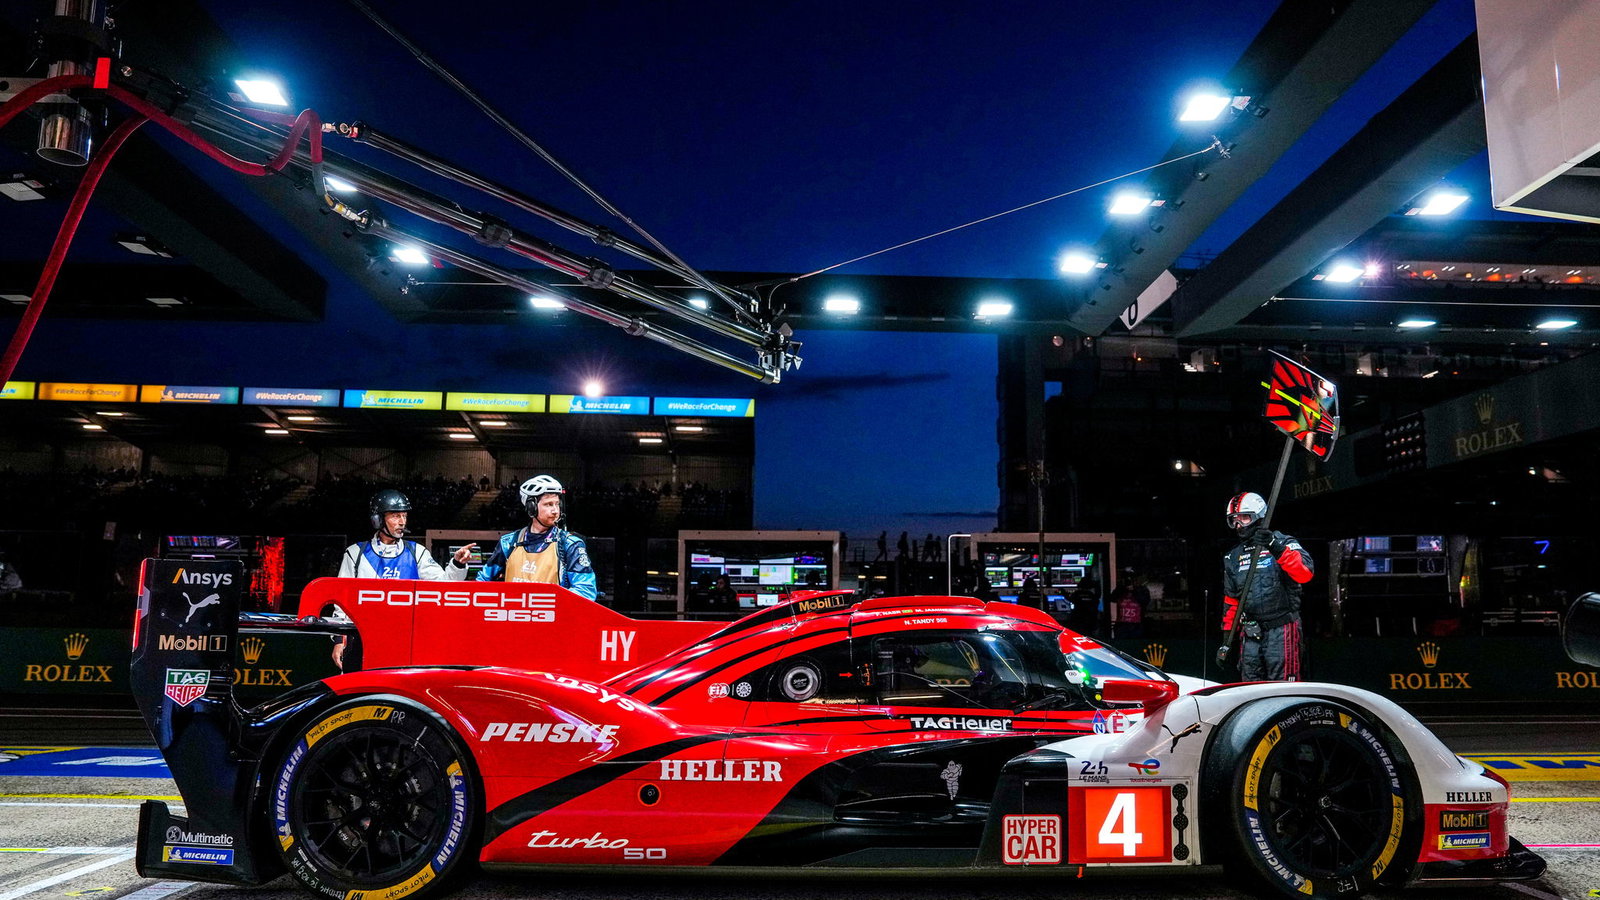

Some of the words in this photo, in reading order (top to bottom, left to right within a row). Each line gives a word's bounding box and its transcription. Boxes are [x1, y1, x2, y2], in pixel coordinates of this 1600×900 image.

[175, 392, 221, 400] MICHELIN
[255, 392, 322, 402] #WeRaceForChange
[462, 398, 529, 407] #WeRaceForChange
[585, 402, 631, 410] MICHELIN
[668, 403, 736, 412] #WeRaceForChange
[1455, 422, 1523, 456] ROLEX
[172, 568, 233, 588] Ansys
[358, 590, 556, 608] PORSCHE
[799, 598, 831, 612] Mobil
[484, 610, 556, 622] 963
[159, 635, 207, 651] Mobil
[601, 630, 636, 661] HY
[24, 665, 112, 682] ROLEX
[170, 671, 207, 684] TAG
[1390, 672, 1471, 690] ROLEX
[167, 686, 205, 703] HEUER
[373, 708, 387, 718] M
[310, 723, 328, 739] PILOT
[330, 712, 353, 726] SPORT
[910, 716, 1012, 731] TAGHeuer
[1095, 723, 1104, 733] N
[1112, 715, 1124, 733] E
[480, 722, 621, 743] PENSKE
[1268, 731, 1278, 745] M
[1359, 728, 1400, 789] MICHELIN
[659, 759, 783, 782] HELLER
[277, 746, 303, 821] MICHELIN
[1446, 792, 1493, 802] HELLER
[1007, 819, 1057, 834] HYPER
[1098, 792, 1143, 857] 4
[1443, 813, 1474, 828] Mobil
[436, 791, 465, 866] MICHELIN
[181, 832, 234, 845] Multimatic
[527, 830, 629, 849] turbo
[1453, 837, 1487, 845] MICHELIN
[624, 848, 667, 860] 50
[1007, 835, 1057, 860] CAR
[1249, 817, 1293, 884] MICHELIN
[183, 852, 227, 861] MICHELIN
[384, 886, 409, 899] SPORT
